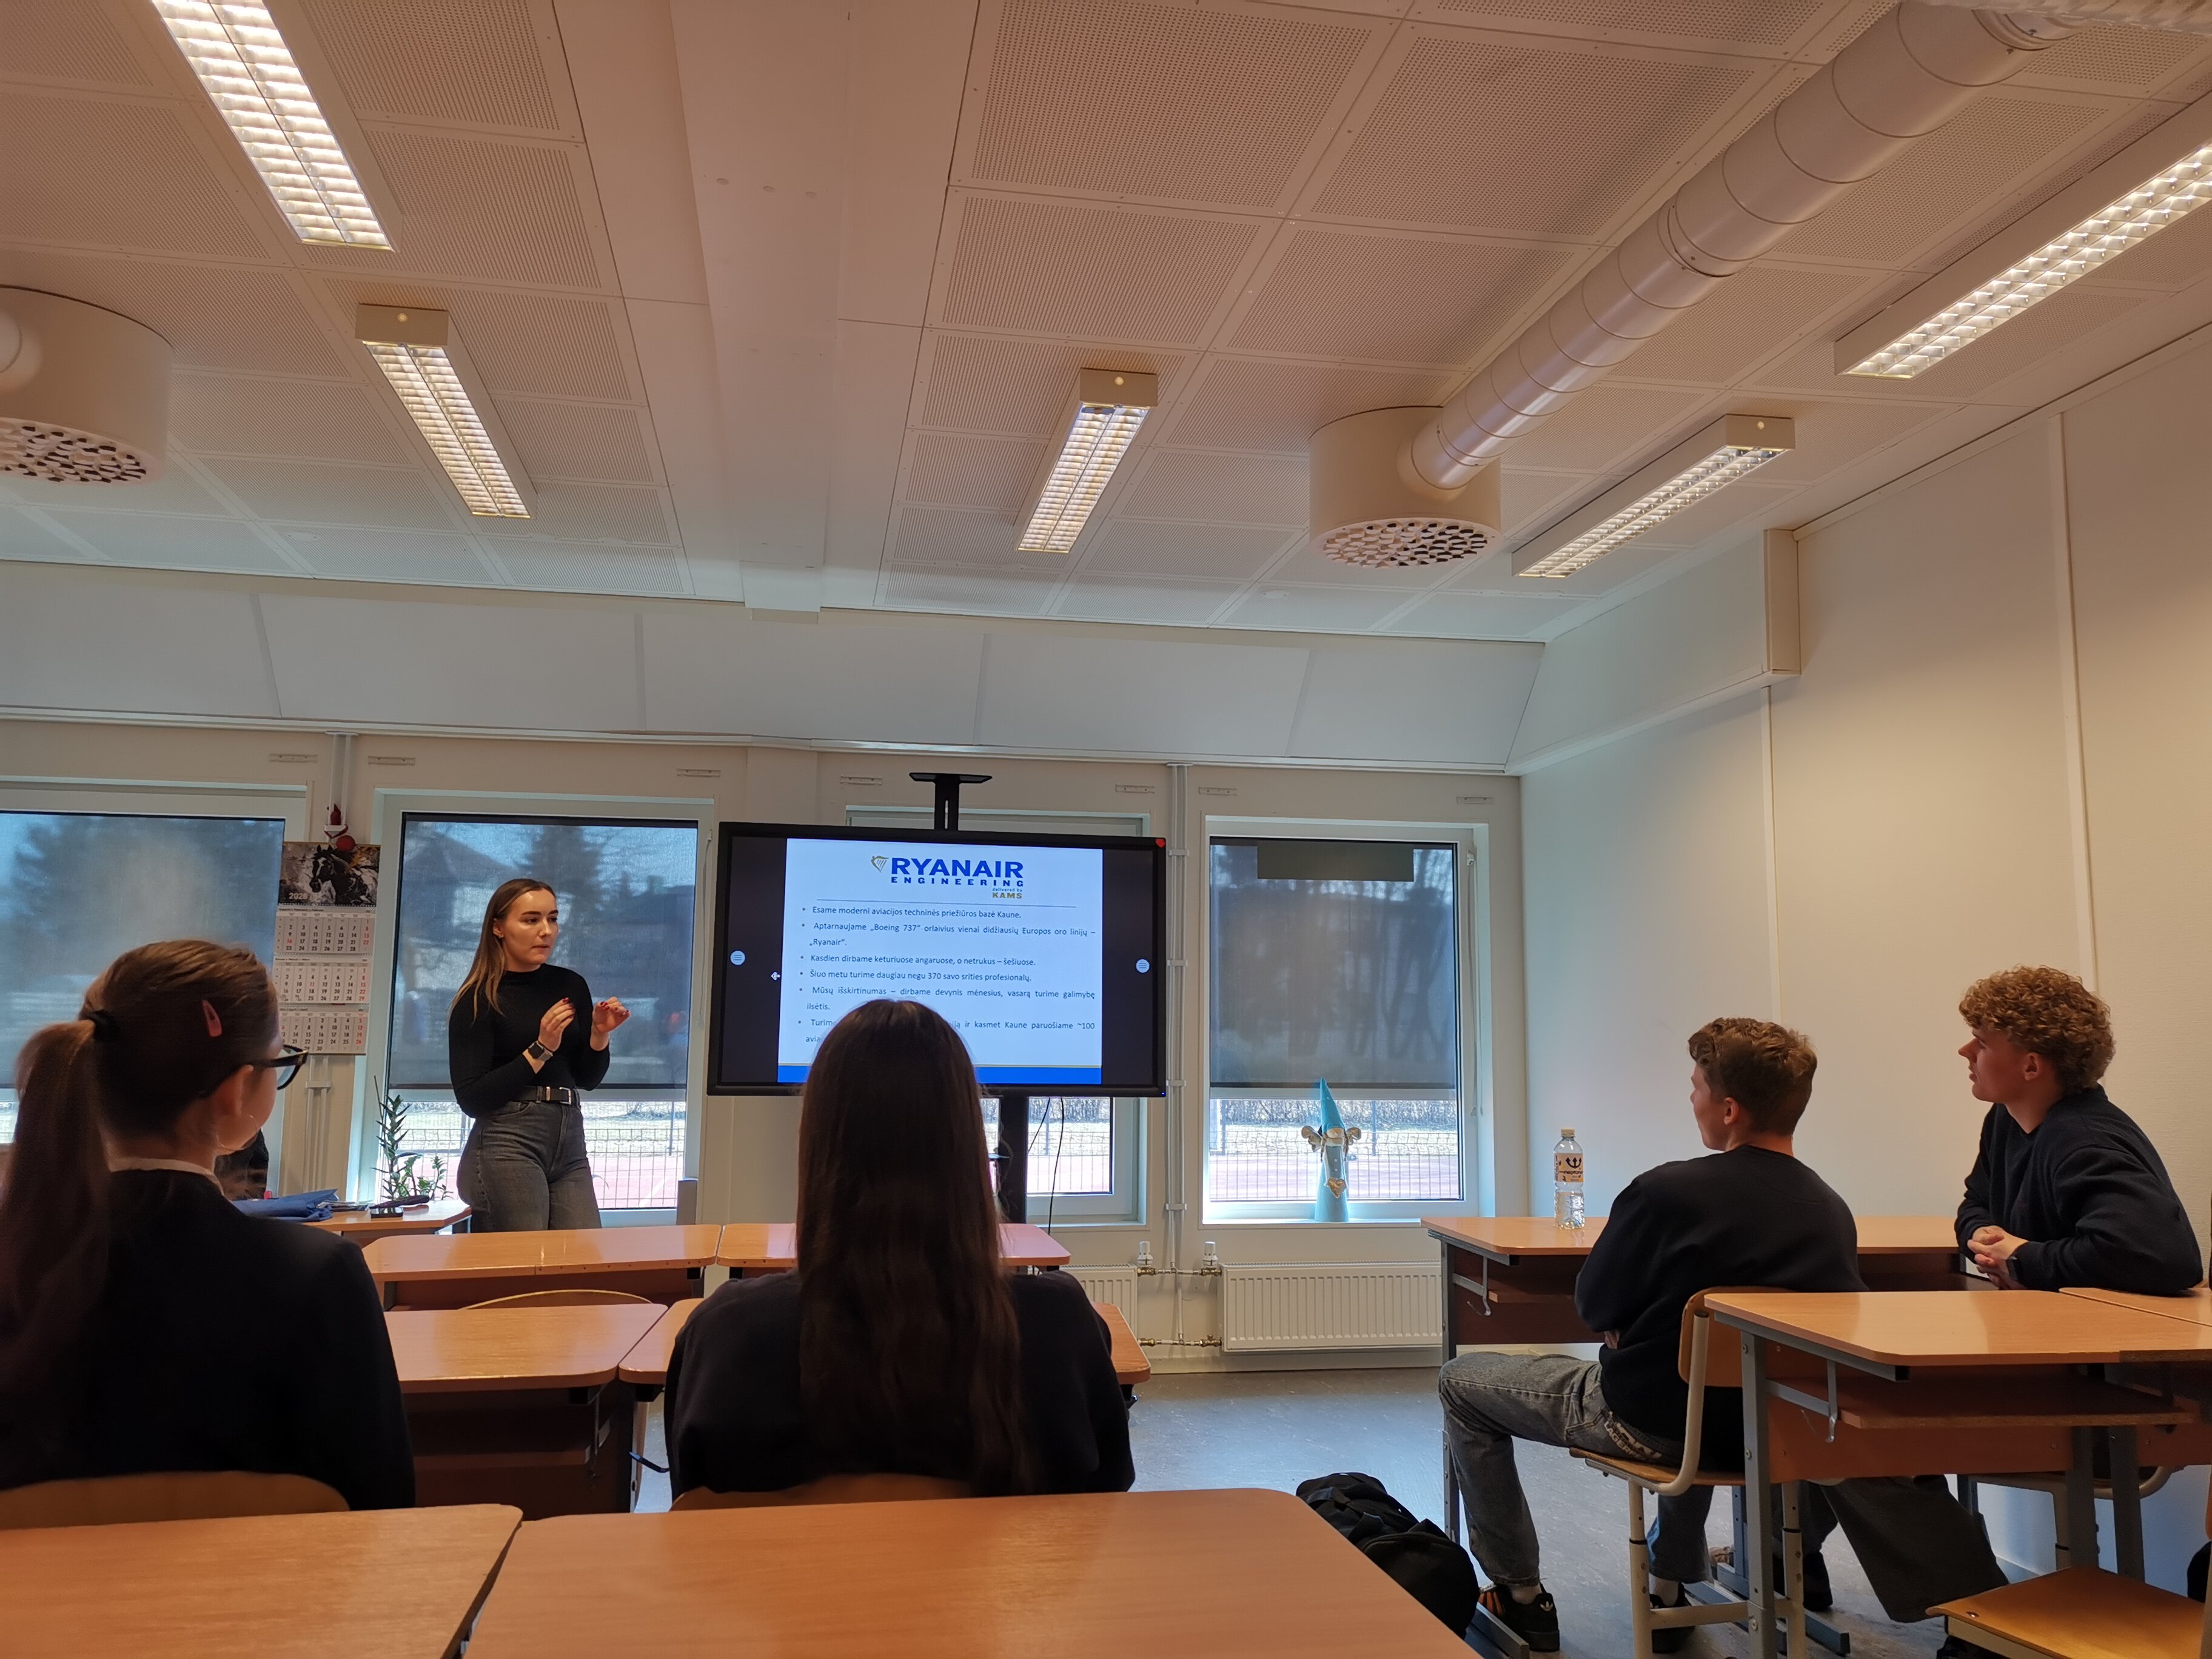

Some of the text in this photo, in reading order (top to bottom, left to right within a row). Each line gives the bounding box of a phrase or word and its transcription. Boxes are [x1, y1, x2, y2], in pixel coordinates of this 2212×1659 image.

[891, 857, 1024, 878] RYANAIR
[891, 877, 1024, 886] ENGINEERING
[871, 908, 902, 916] aviacijos
[941, 910, 976, 918] priežiūros
[814, 923, 866, 931] Aptarnaujame
[870, 924, 899, 933] „Boeing
[983, 926, 1018, 935] didžiausių
[1022, 928, 1051, 936] Europos
[877, 971, 905, 980] daugiau
[985, 974, 1031, 982] profesionalų.
[813, 987, 833, 995] Mūsų
[967, 989, 1003, 997] mėnesius,
[1063, 990, 1095, 999] galimybę
[1031, 1022, 1073, 1030] paruošiame
